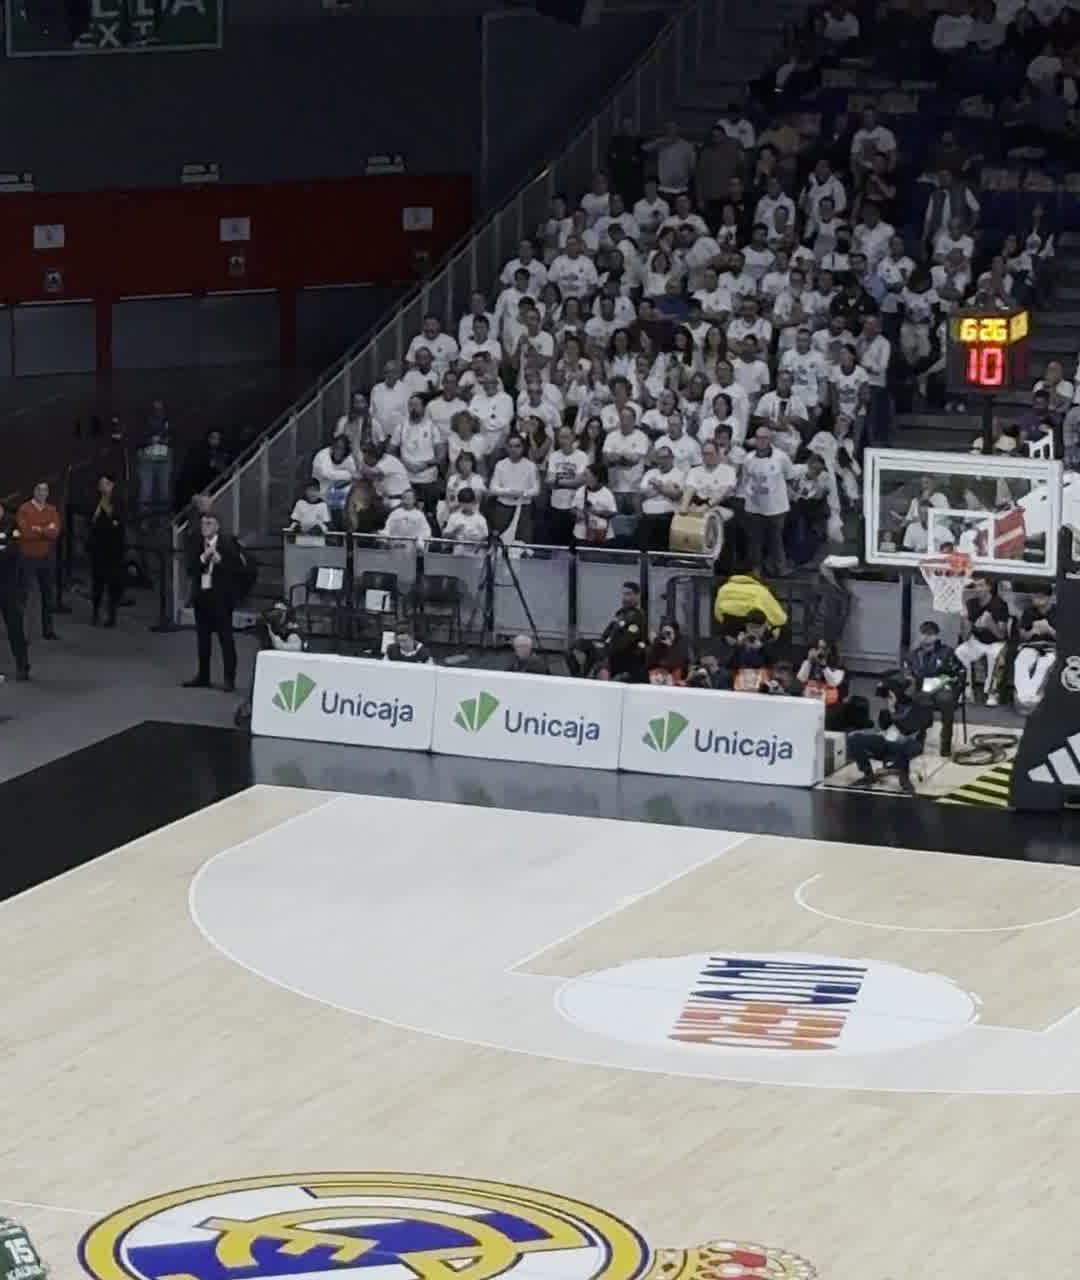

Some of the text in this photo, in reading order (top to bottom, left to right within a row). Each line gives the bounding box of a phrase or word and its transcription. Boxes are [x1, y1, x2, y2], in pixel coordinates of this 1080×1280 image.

[968, 347, 1003, 385] 10
[320, 690, 415, 729] Unicaja
[504, 709, 601, 747] Unicaja
[693, 727, 794, 766] Unicaja
[4, 1238, 35, 1264] 15
